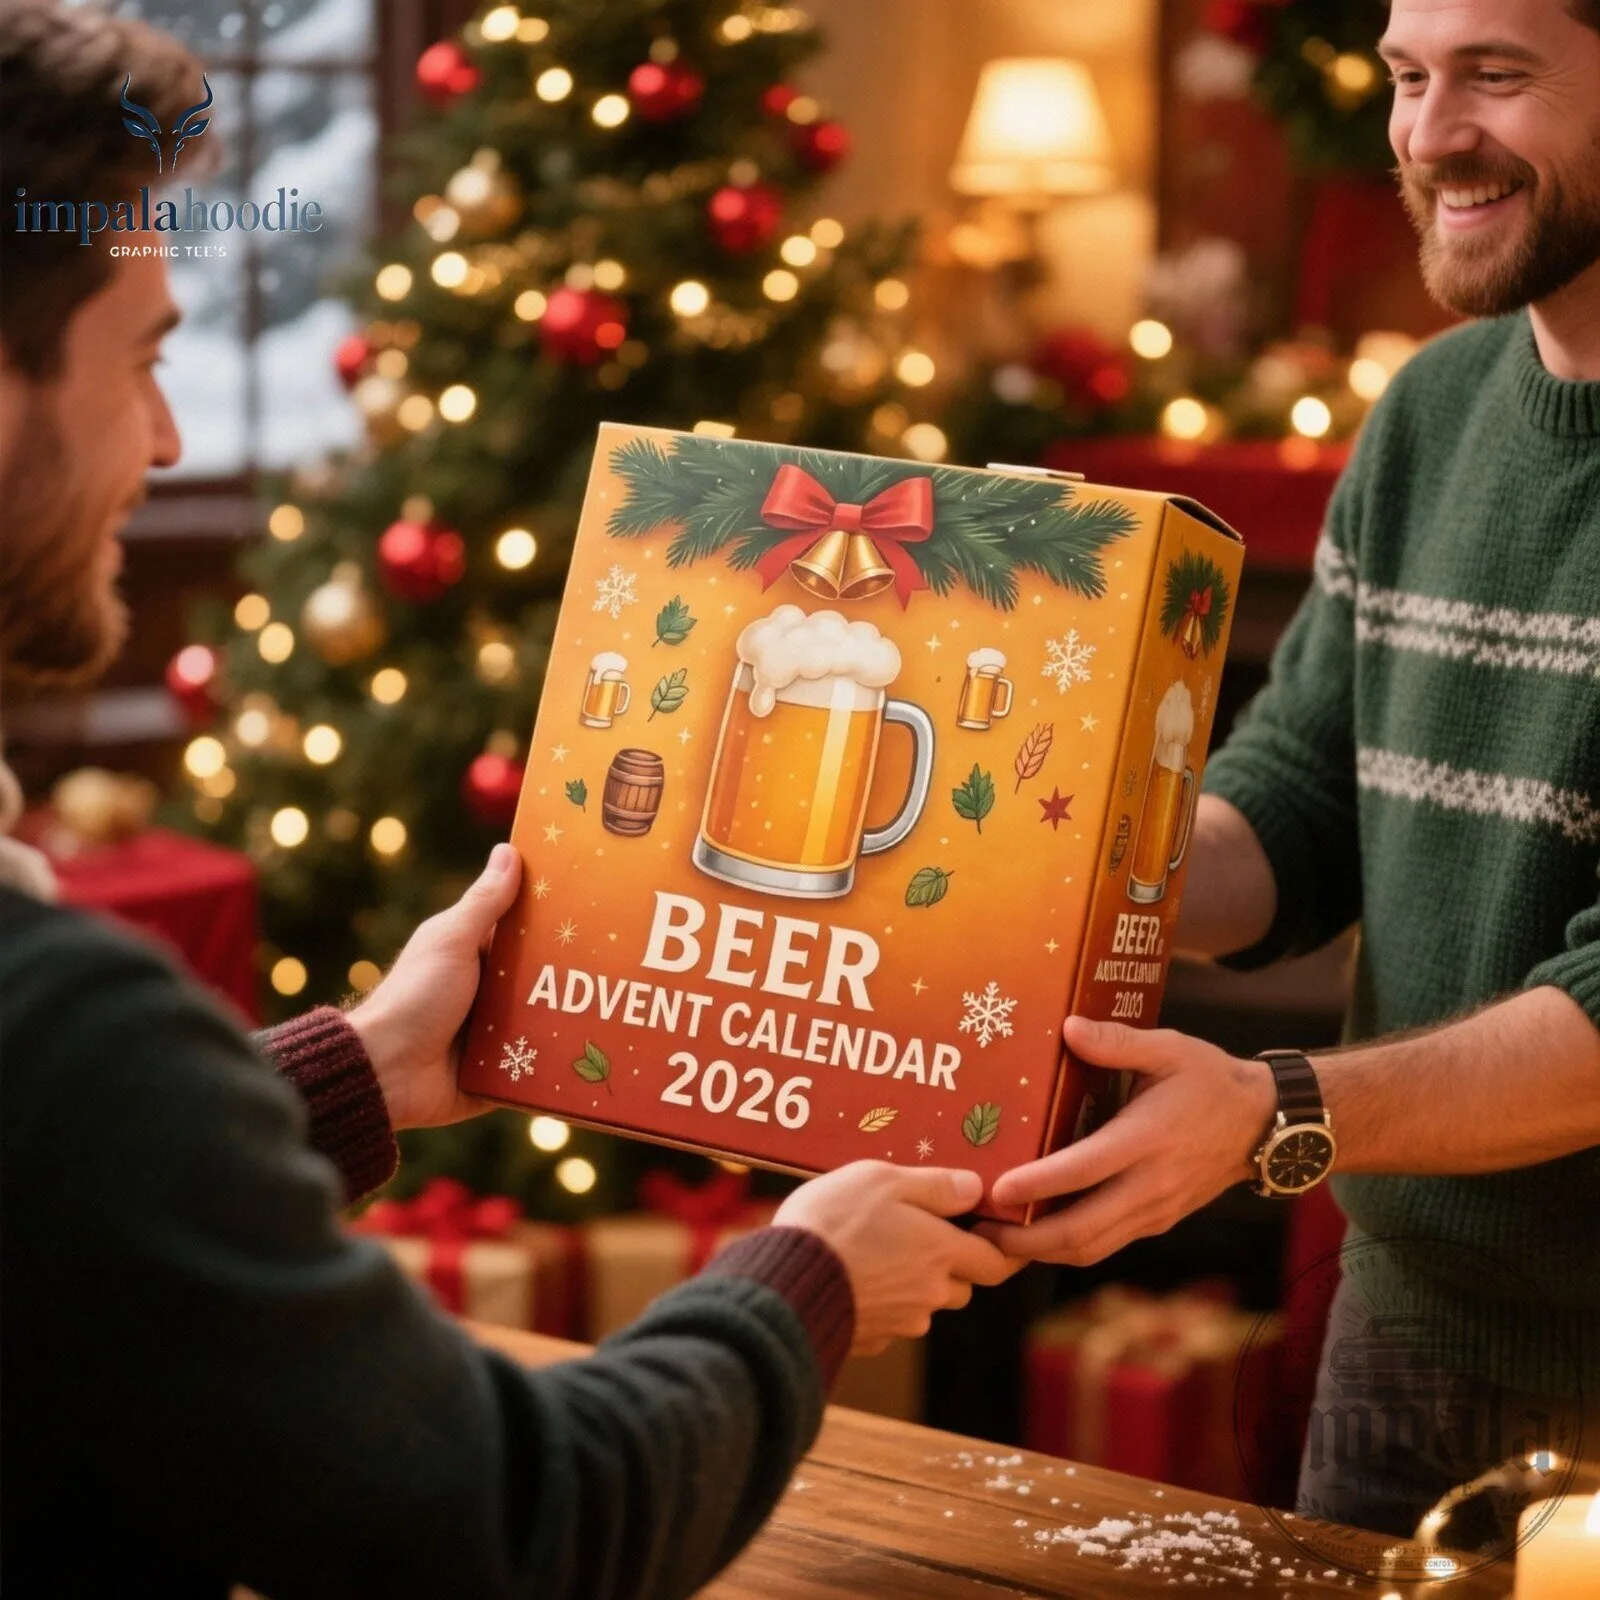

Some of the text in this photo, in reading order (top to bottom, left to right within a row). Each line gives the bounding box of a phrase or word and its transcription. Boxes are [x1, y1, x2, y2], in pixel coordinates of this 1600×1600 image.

[641, 891, 880, 1011] BEER
[1112, 913, 1160, 955] BEER
[527, 964, 962, 1090] ADVENT CALENDAR
[660, 1051, 813, 1129] 2026
